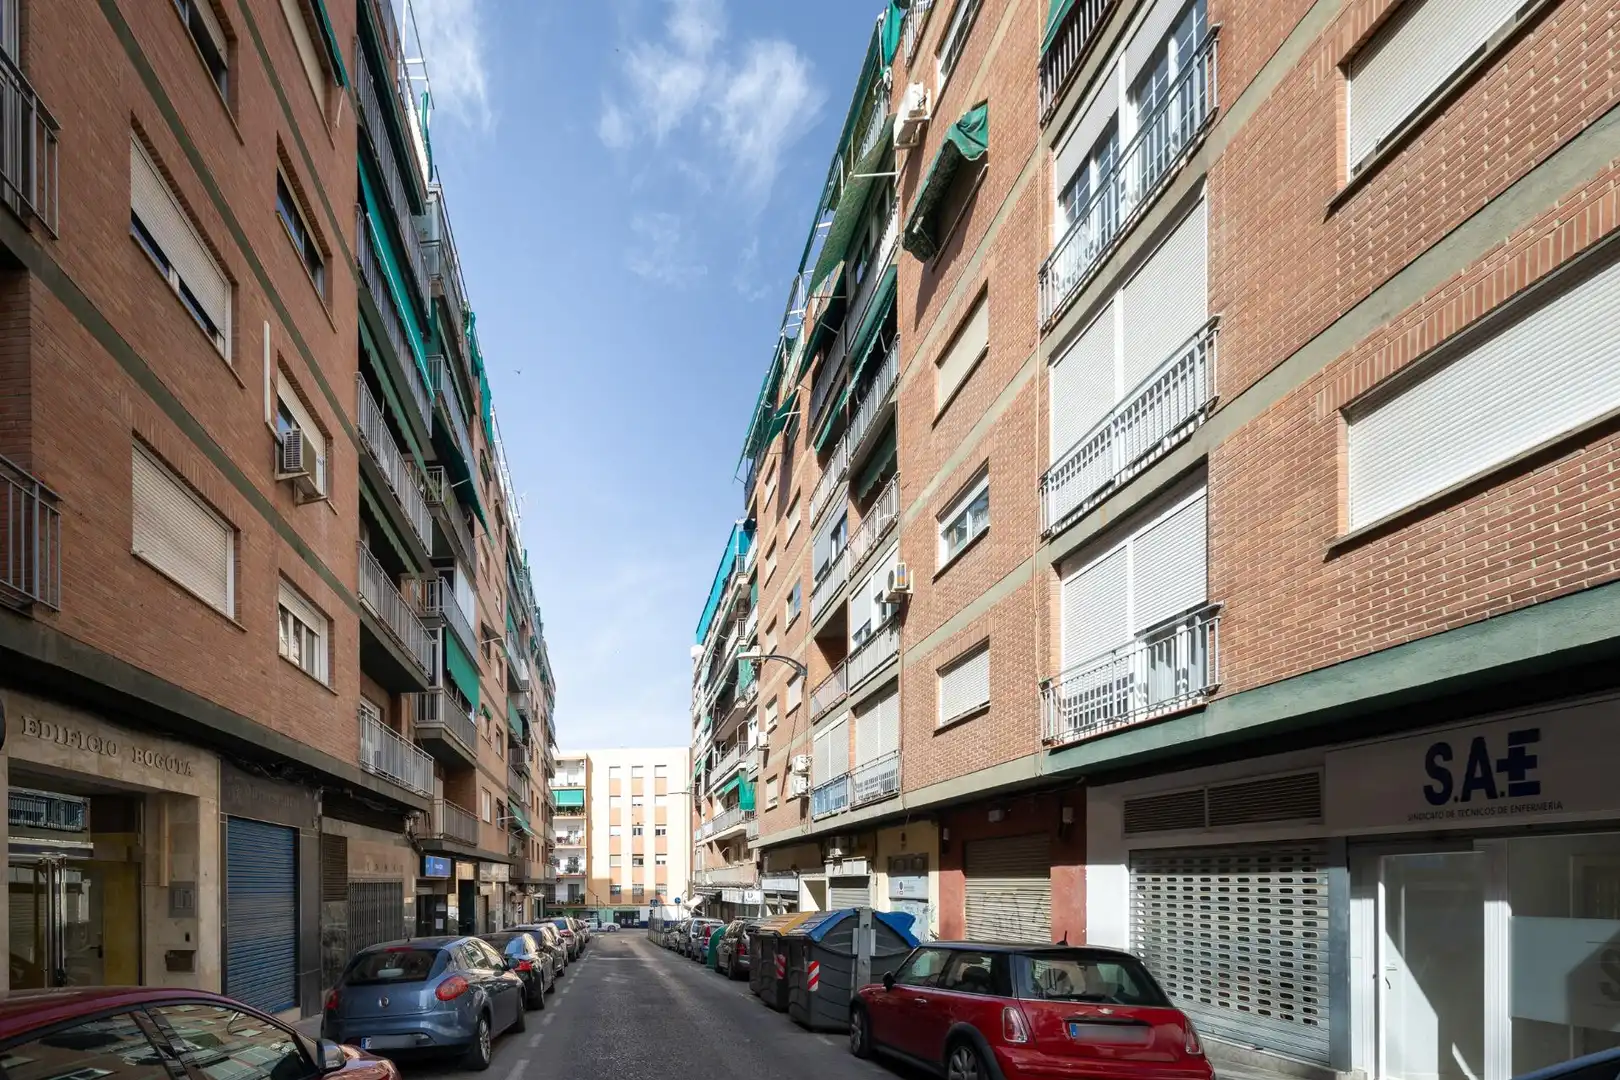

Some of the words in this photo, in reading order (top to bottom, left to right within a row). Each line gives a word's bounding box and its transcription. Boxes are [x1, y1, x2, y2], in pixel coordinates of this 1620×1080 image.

[21, 715, 119, 758] EDIFICIO
[132, 745, 193, 777] BOGOTA
[1407, 810, 1444, 821] SINDICATO
[1446, 809, 1455, 818] DE
[1497, 805, 1508, 814] DE
